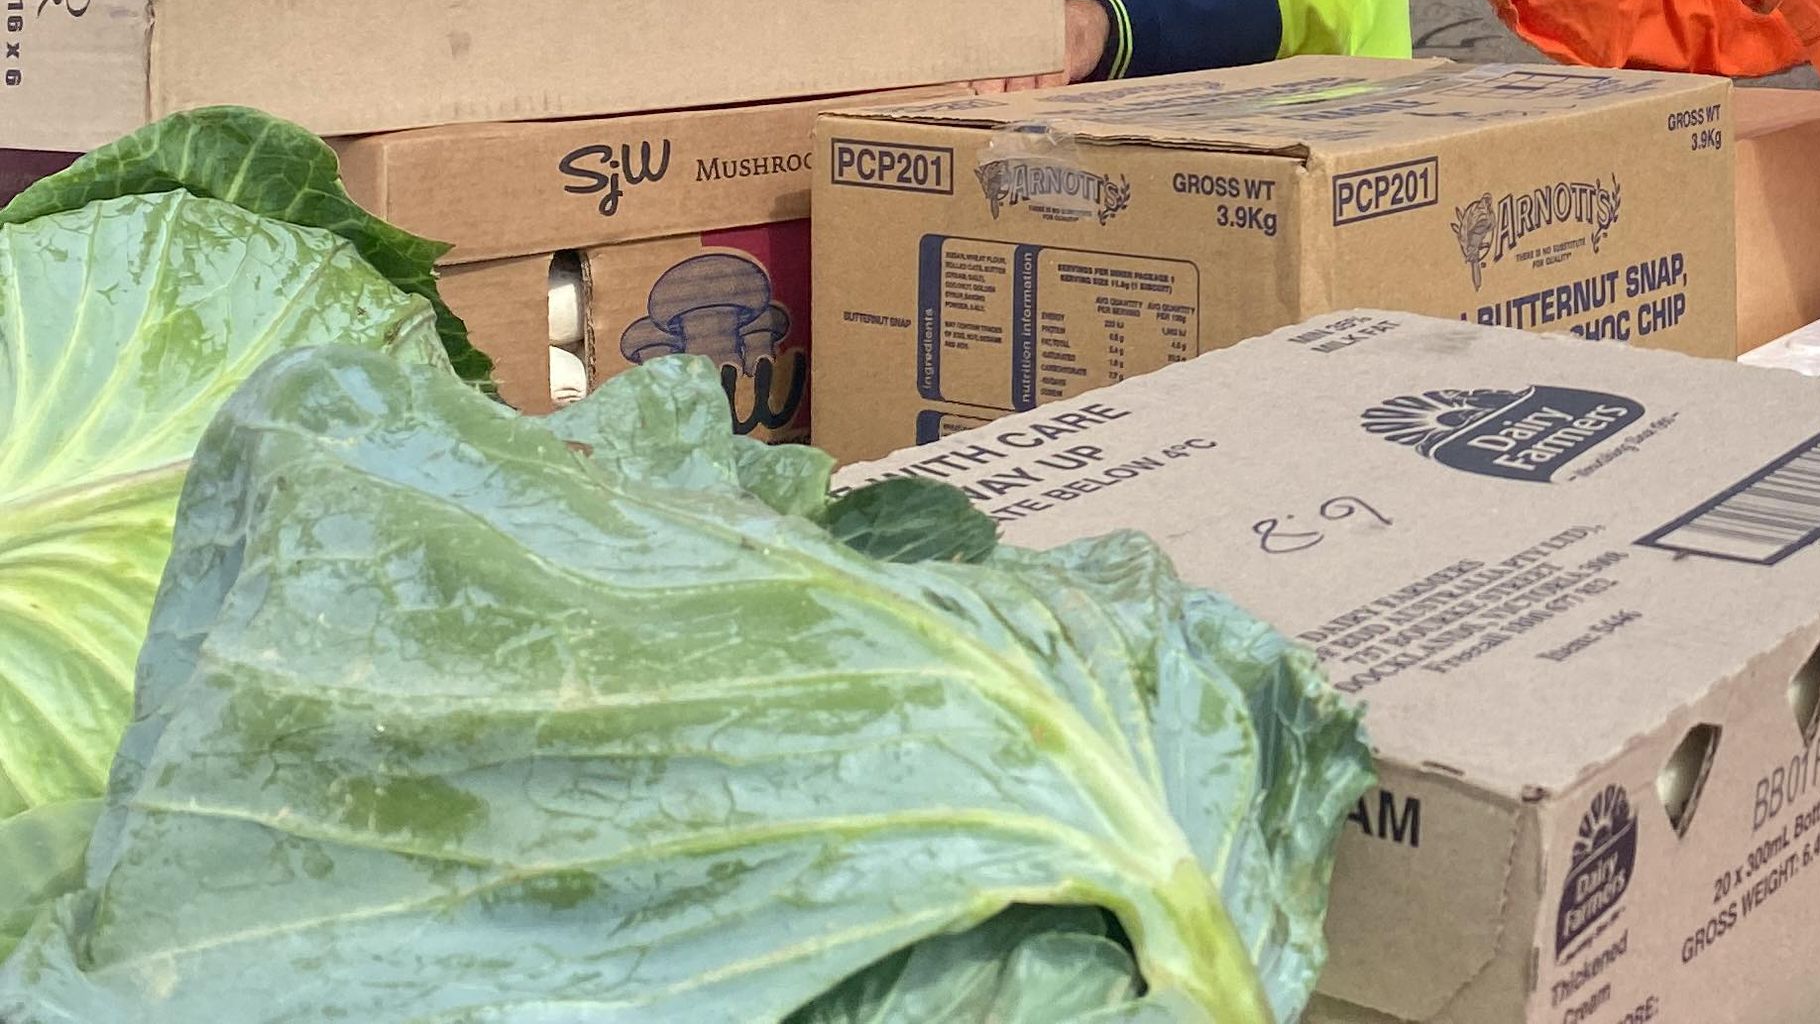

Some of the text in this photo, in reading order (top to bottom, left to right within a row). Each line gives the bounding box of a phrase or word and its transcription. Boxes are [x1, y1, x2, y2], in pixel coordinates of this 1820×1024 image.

[6, 68, 22, 87] 6
[1668, 104, 1721, 132] GROSS WT
[1691, 127, 1722, 152] 3.9Kg
[837, 147, 944, 188] PCP201
[1172, 171, 1276, 201] GROSS WT
[1338, 166, 1431, 217] PCP201
[1217, 204, 1278, 237] 3.9Kg
[1021, 253, 1032, 337] information
[1477, 252, 1687, 330] BUTTERNUT SNAP,
[1637, 292, 1686, 336] CHIP
[1358, 320, 1400, 335] FAT
[1022, 340, 1032, 403] nutrition
[997, 404, 1130, 448] CARE
[1467, 406, 1574, 451] Dairy
[1493, 404, 1628, 471] Farmers
[1035, 445, 1104, 471] UP
[1041, 456, 1165, 502] BELOW
[1296, 558, 1485, 643] DAIRY FARMERS
[1380, 600, 1487, 648] BOURKE
[1476, 561, 1563, 603] STREET
[1478, 571, 1592, 620] VICTORIA
[1347, 789, 1419, 848] AM
[1713, 872, 1731, 904] 20
[1732, 866, 1744, 887] x
[1745, 833, 1791, 876] 300mL
[1682, 903, 1738, 964] GROSS
[1741, 859, 1800, 918] WEIGHT:
[1552, 928, 1628, 1009] Thickened
